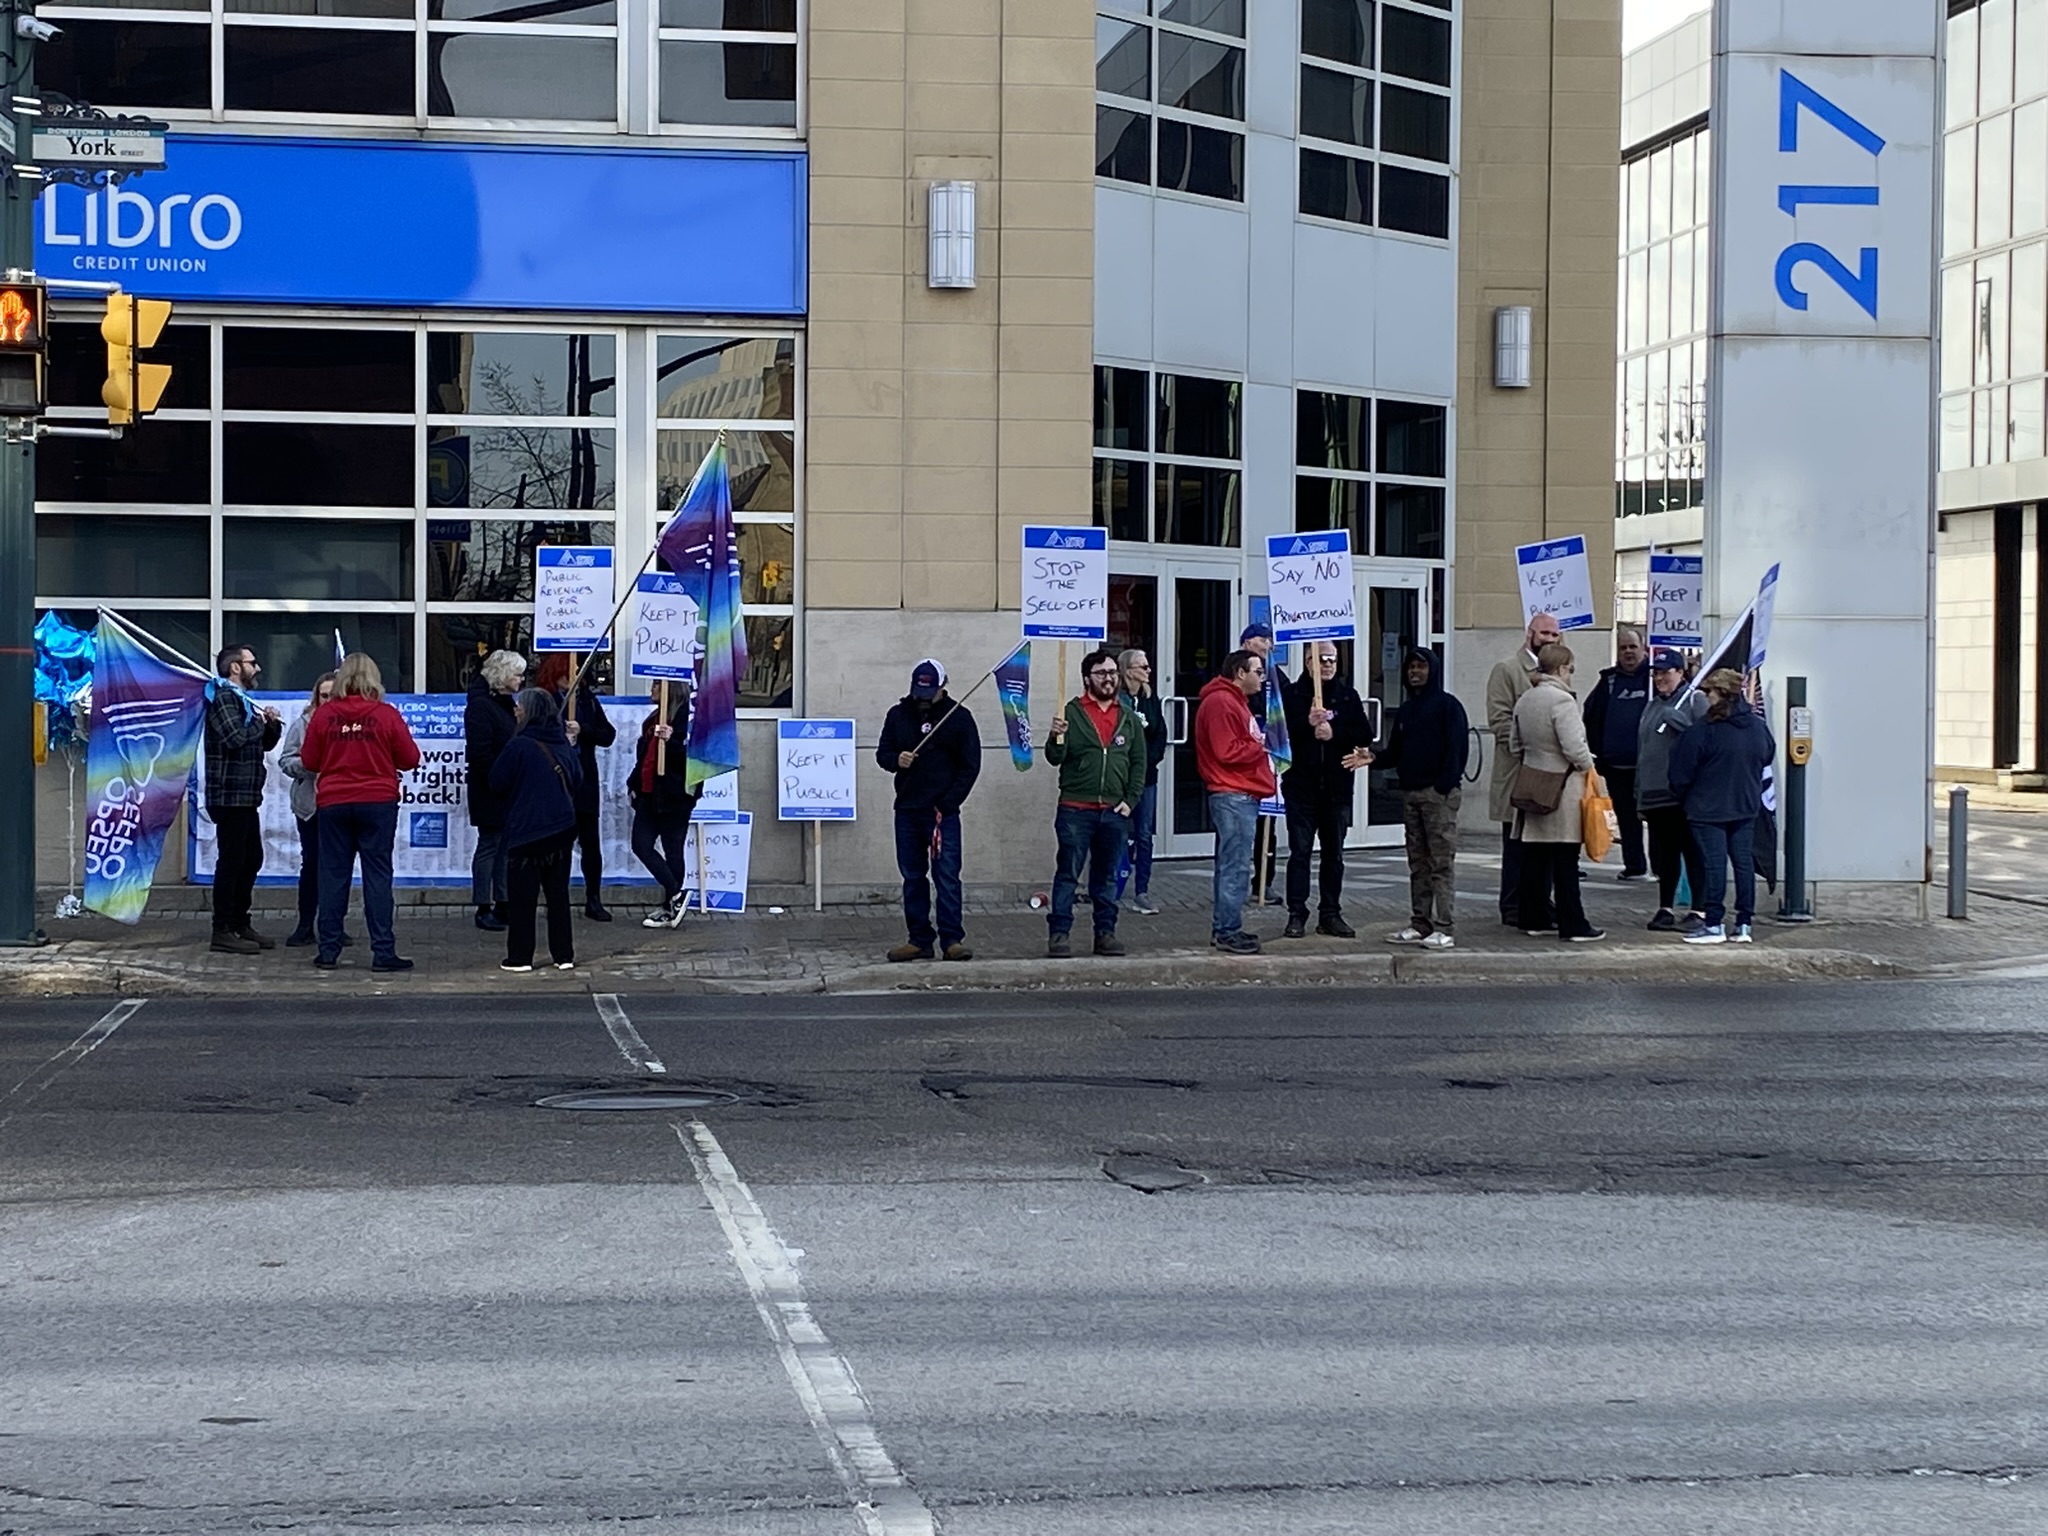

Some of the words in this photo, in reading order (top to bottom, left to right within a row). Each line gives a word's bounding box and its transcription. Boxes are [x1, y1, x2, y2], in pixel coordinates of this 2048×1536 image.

[67, 136, 116, 156] York
[1775, 68, 1886, 321] 217
[44, 171, 242, 250] Libro
[73, 256, 139, 270] CREDIT
[146, 258, 207, 272] UNION
[1032, 557, 1085, 579] STOP
[1271, 561, 1304, 585] SAY
[1046, 579, 1077, 590] THE
[1526, 570, 1564, 588] KEEP
[1300, 586, 1316, 595] TO
[1544, 586, 1555, 597] IT
[1651, 581, 1688, 602] KEEP
[1696, 589, 1702, 602] I
[639, 601, 677, 622] KEEP
[683, 610, 699, 626] IT
[1652, 607, 1700, 633] PUBLI
[635, 626, 696, 655] PUBLIC
[429, 724, 457, 734] LCBO
[422, 751, 465, 763] wor
[786, 749, 825, 768] KEEP
[834, 754, 851, 768] IT
[412, 765, 469, 788] fighti
[403, 786, 460, 805] back!
[784, 775, 849, 800] PUBLIC!
